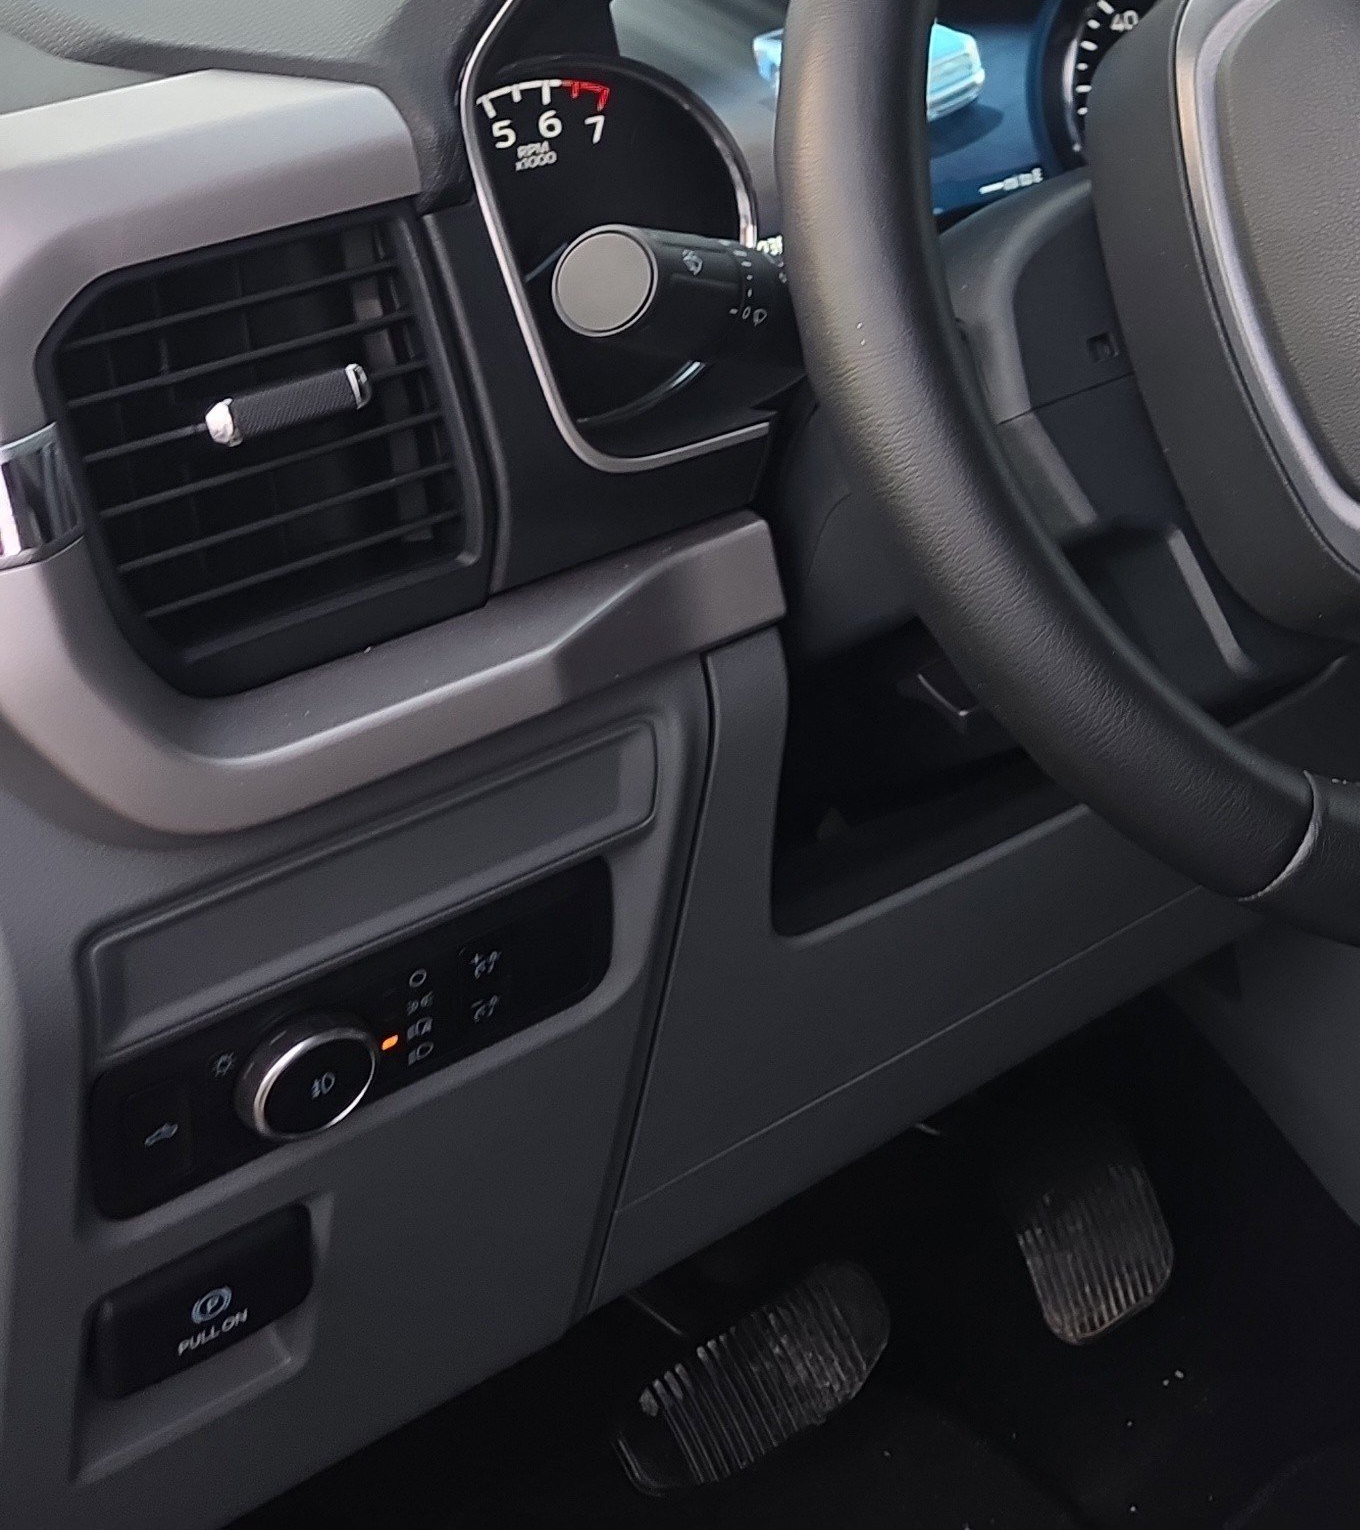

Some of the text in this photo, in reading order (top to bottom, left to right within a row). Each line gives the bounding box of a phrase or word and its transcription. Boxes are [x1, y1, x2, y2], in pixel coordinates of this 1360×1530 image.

[1110, 9, 1139, 32] 40
[491, 109, 605, 149] 5 6 7
[517, 140, 550, 159] RPM
[177, 1308, 249, 1356] PULL ON
